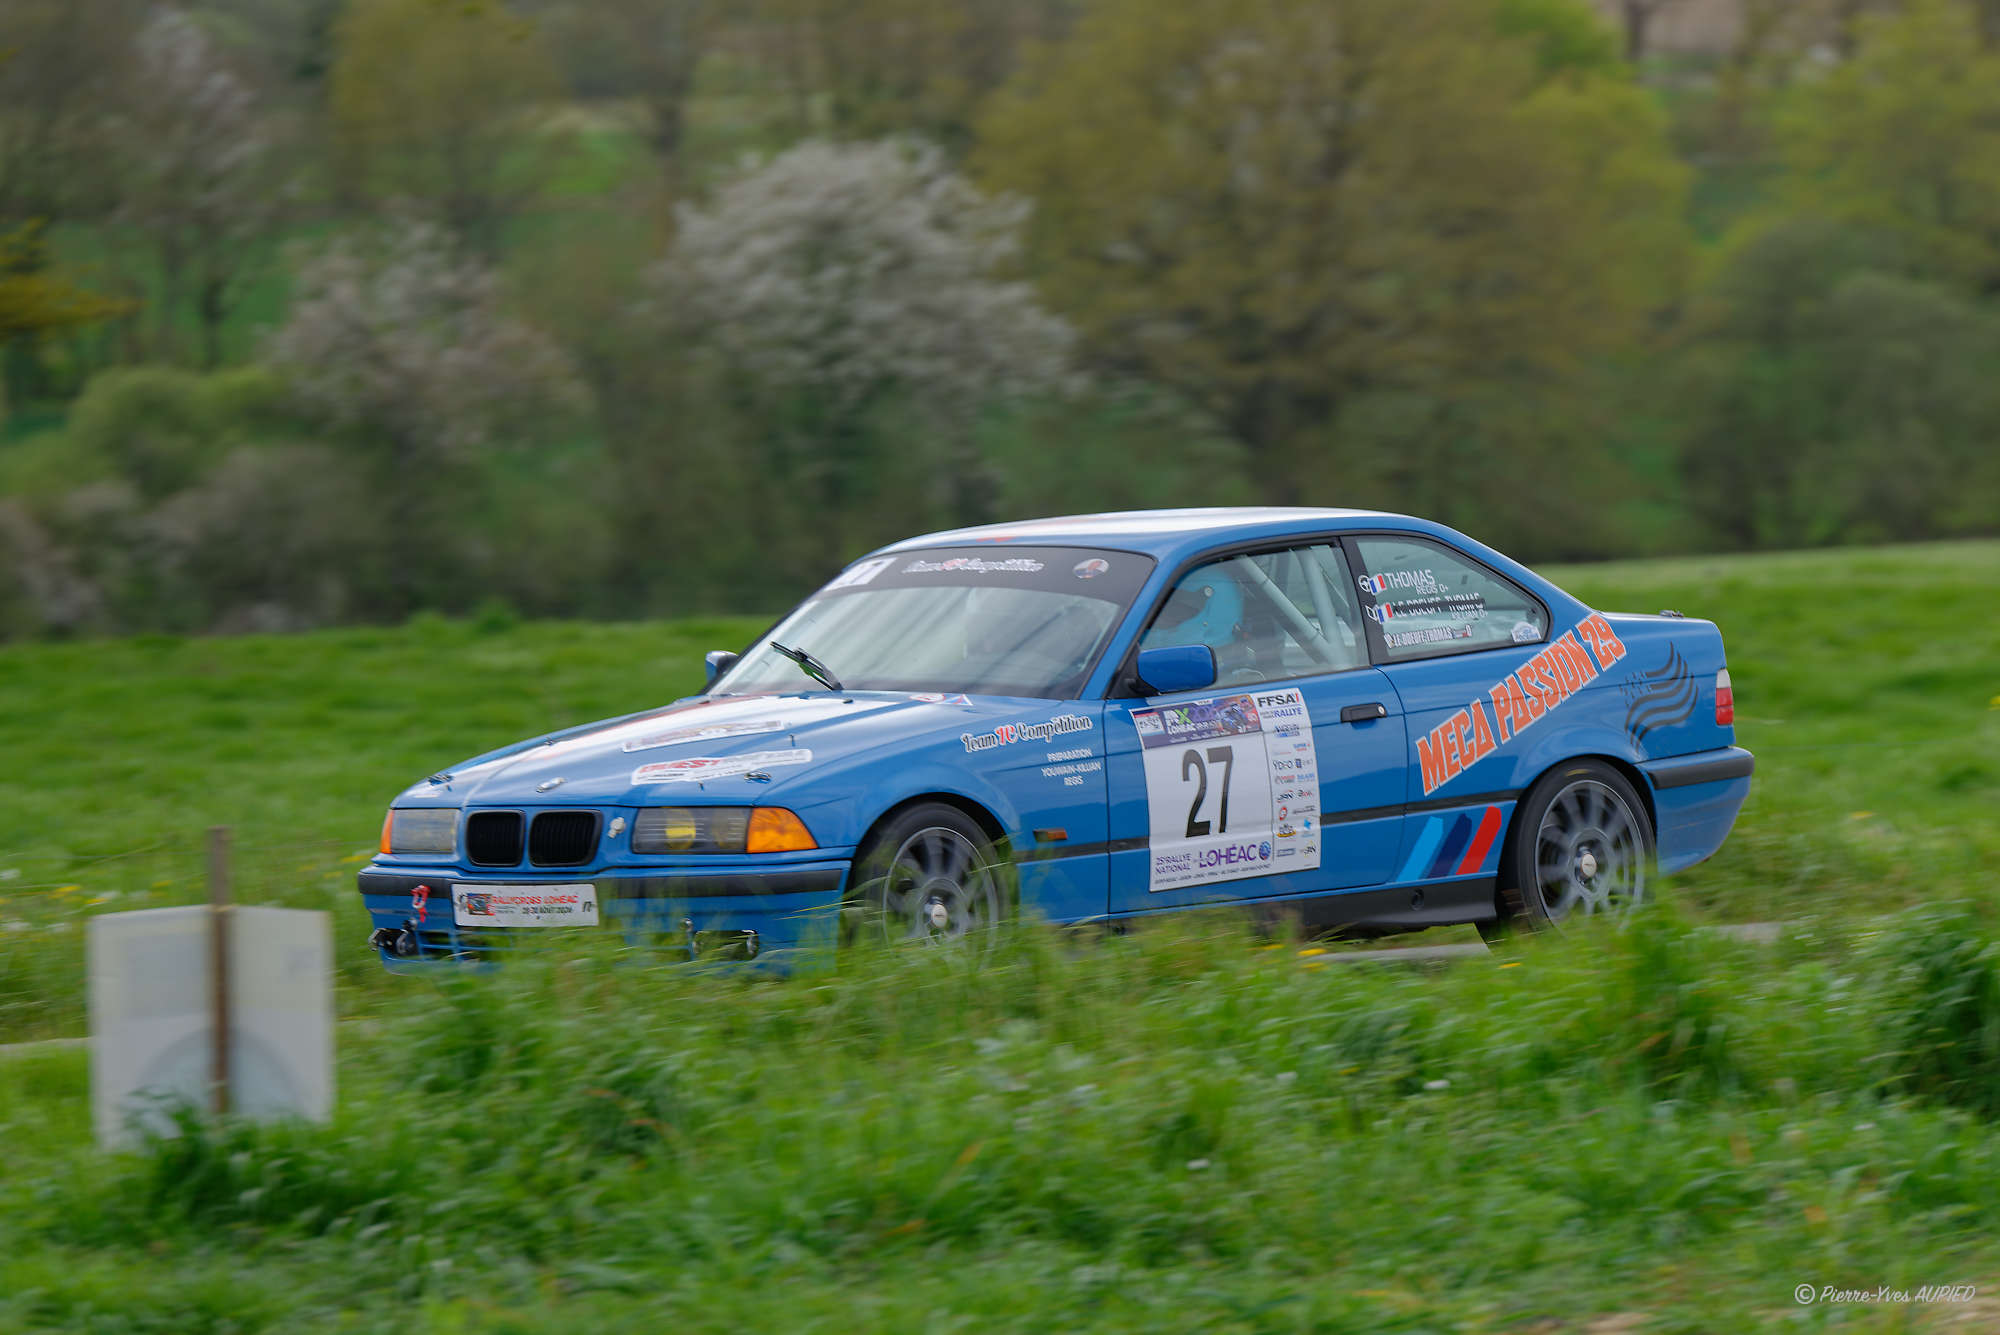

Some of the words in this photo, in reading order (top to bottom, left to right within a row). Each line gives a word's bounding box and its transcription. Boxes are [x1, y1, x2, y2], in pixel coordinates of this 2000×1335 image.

[1384, 569, 1435, 590] THOMAS
[1257, 693, 1296, 707] FFSA
[1415, 698, 1498, 796] MECA
[1488, 629, 1600, 744] PASSION
[1575, 612, 1627, 672] 29
[1273, 707, 1303, 718] RALLYE
[961, 734, 997, 751] Team
[1182, 745, 1233, 838] 27
[1199, 843, 1257, 868] LOHÉAC
[1155, 862, 1192, 874] NATIONAL
[492, 896, 541, 904] RALLYCROSS
